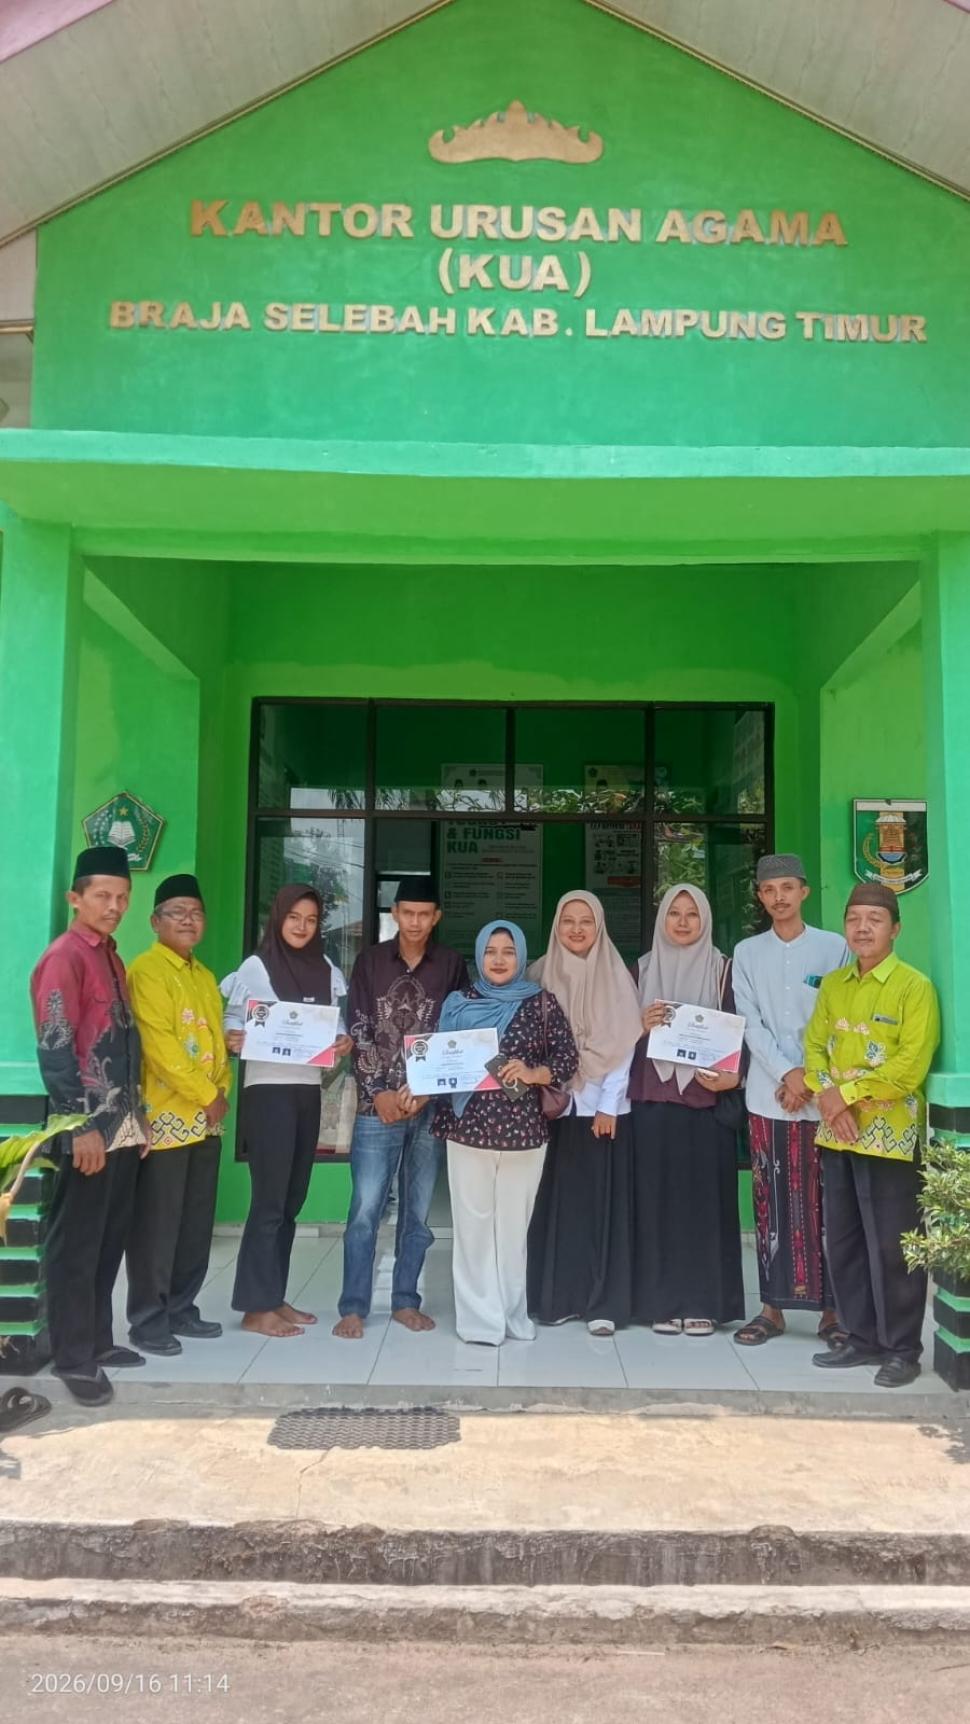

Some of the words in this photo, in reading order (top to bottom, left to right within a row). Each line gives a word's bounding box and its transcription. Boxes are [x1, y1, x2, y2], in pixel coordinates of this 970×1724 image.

[190, 199, 414, 239] KANTOR
[430, 204, 642, 243] URUSAN
[656, 208, 848, 247] AGAMA
[438, 247, 591, 299] (KUA)
[109, 301, 251, 332] BRAJA
[264, 304, 456, 336] SELEBAH
[468, 307, 573, 338] KAB.
[585, 308, 787, 340] LAMPUNG
[796, 311, 928, 343] TIMUR
[447, 827, 456, 839] &
[463, 827, 521, 840] FUNGSI
[447, 841, 478, 853] KUA
